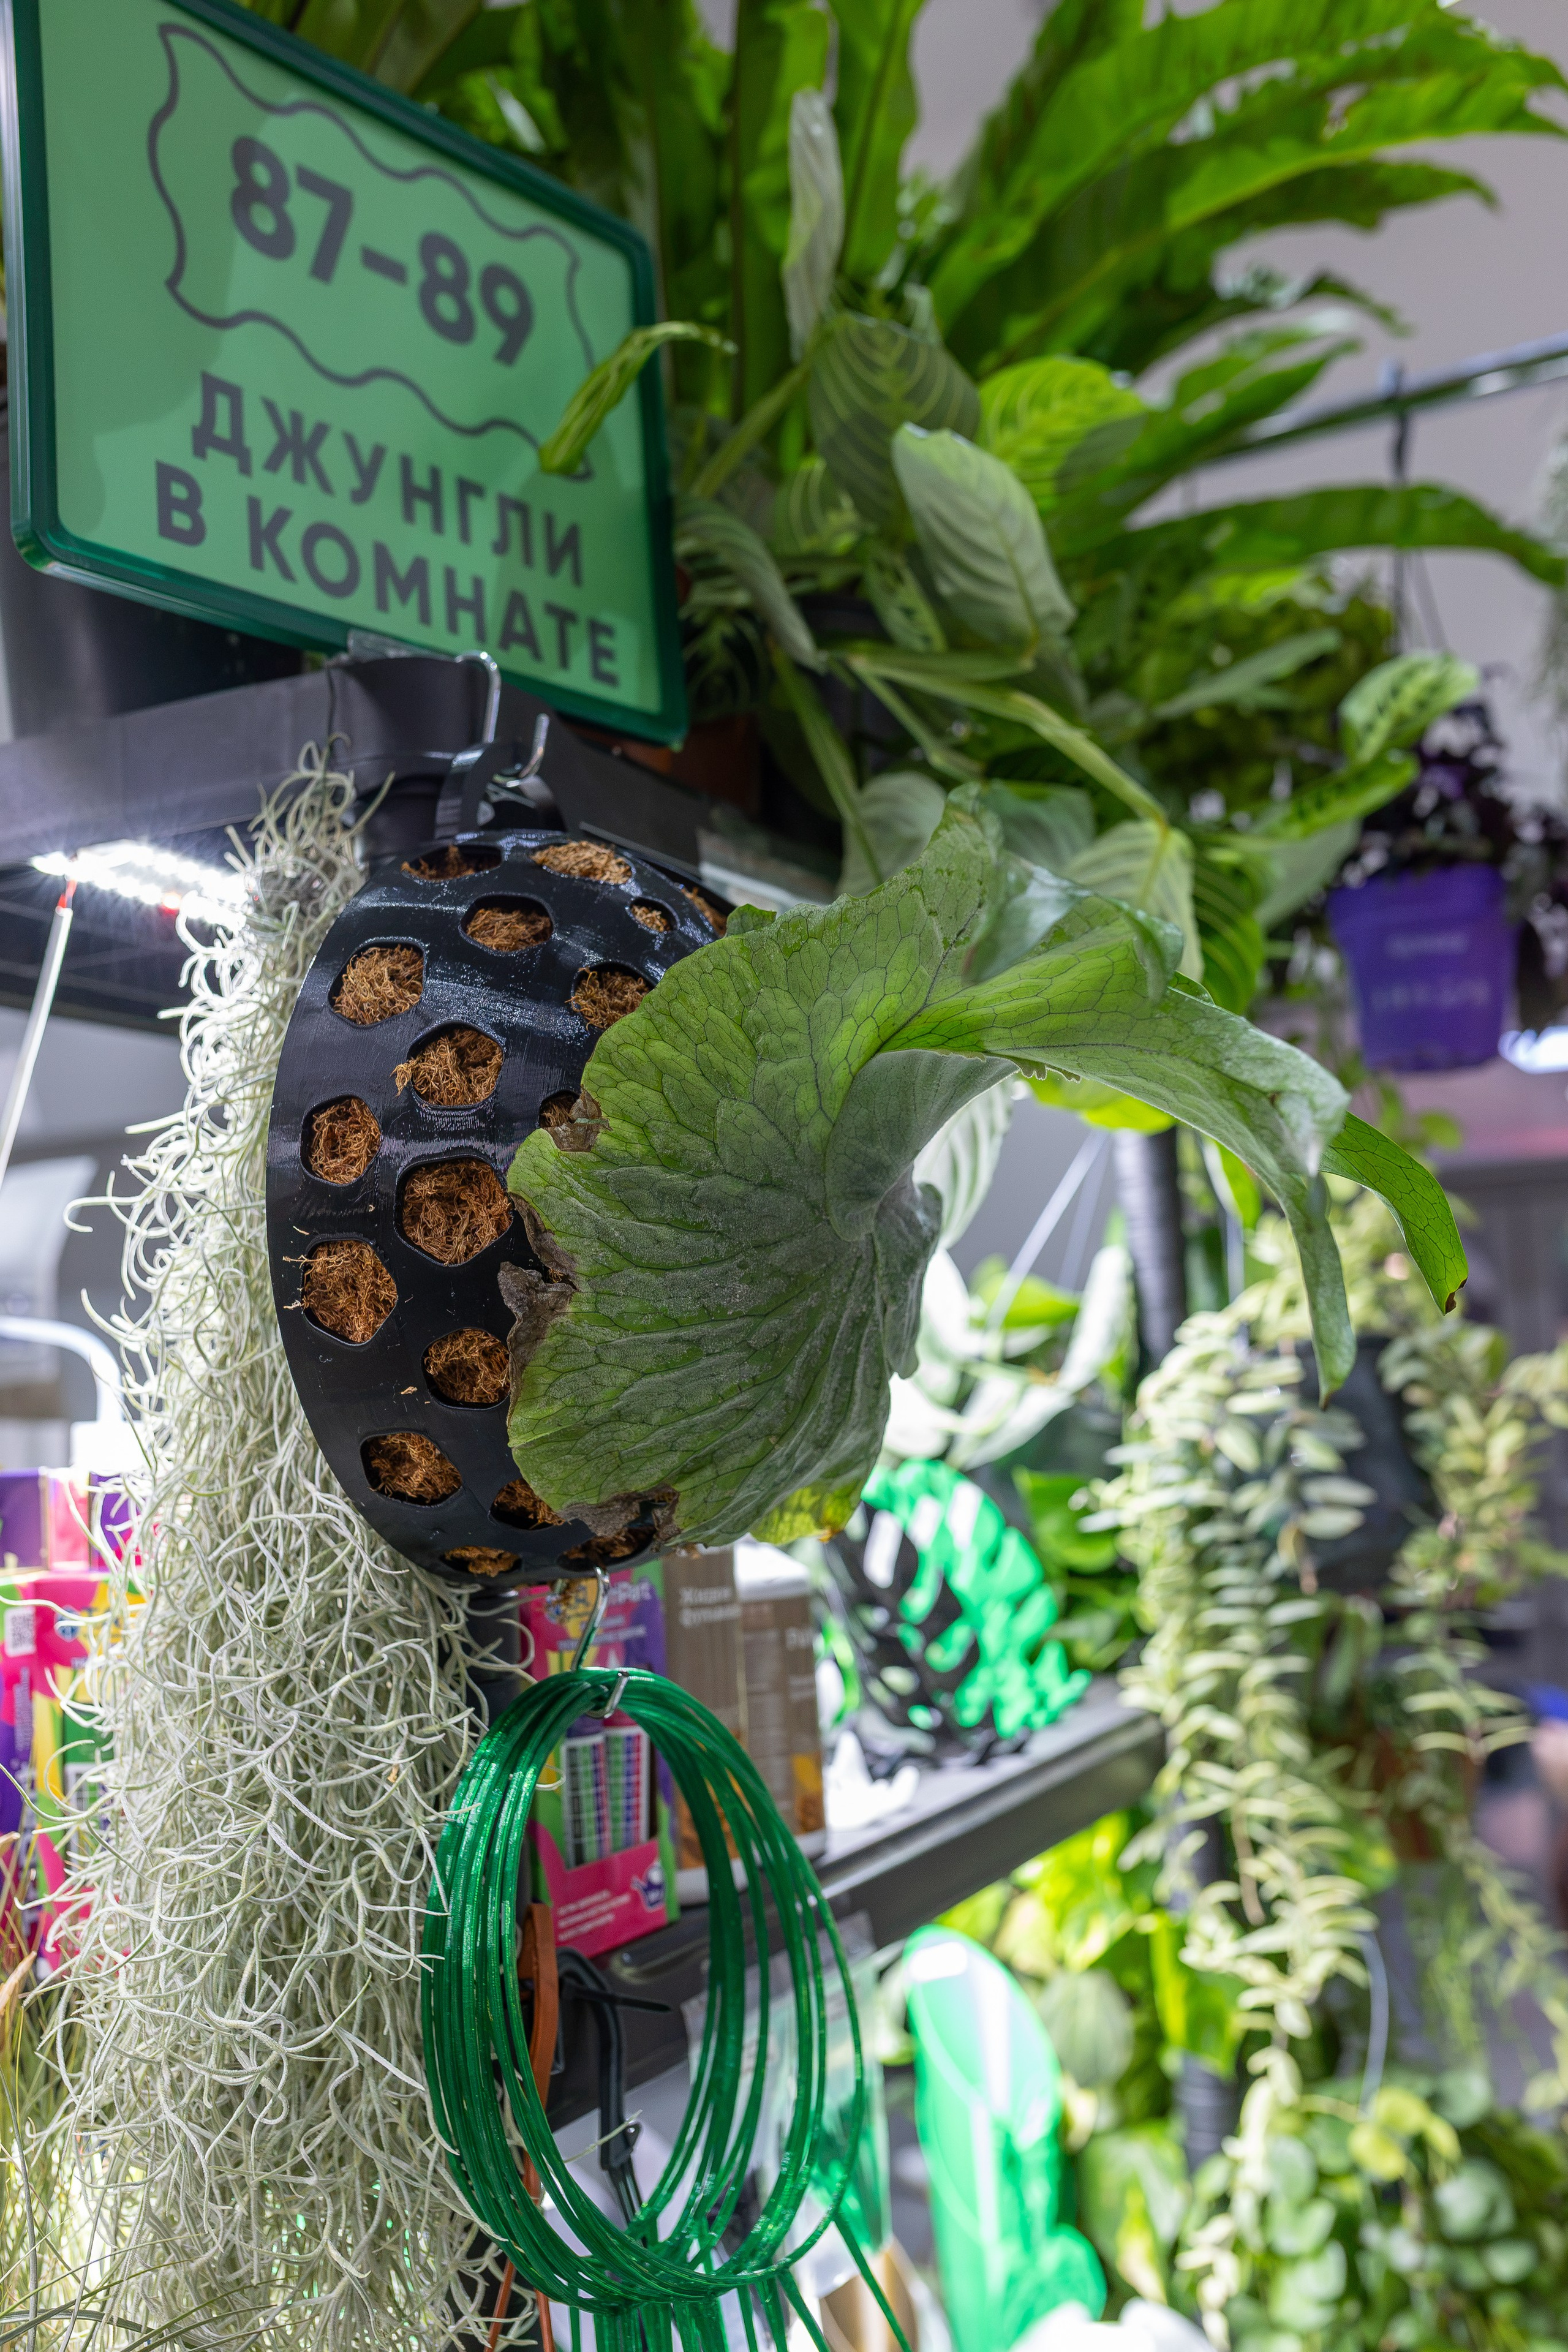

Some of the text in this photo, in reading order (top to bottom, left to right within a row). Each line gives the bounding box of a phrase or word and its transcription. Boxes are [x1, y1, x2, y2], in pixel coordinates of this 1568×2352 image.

[155, 459, 620, 689] В КОМНАТЕ
[191, 371, 583, 589] ДЖУНГЛИ
